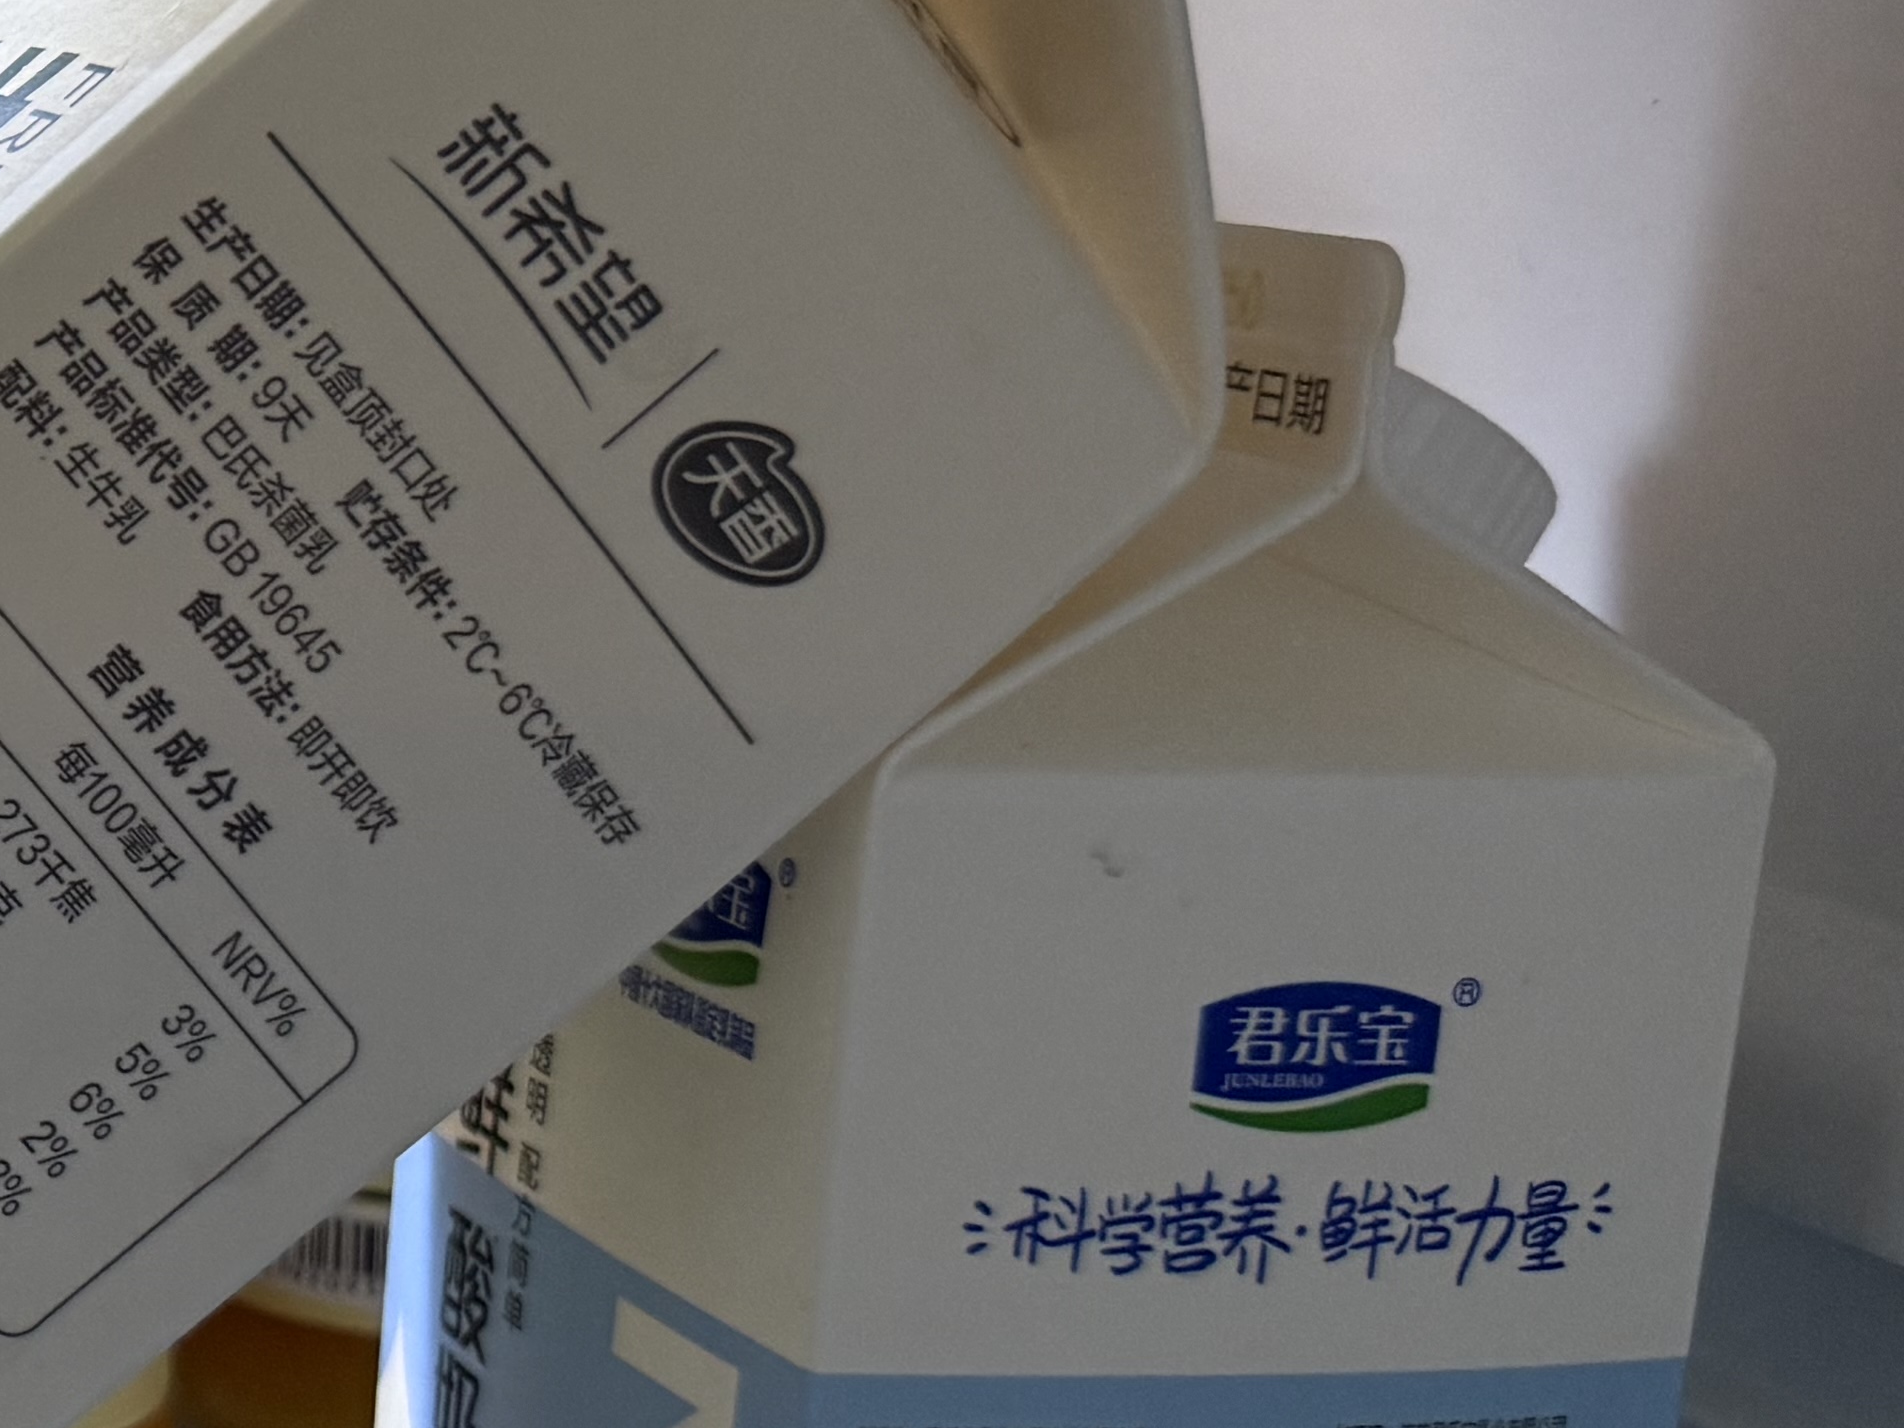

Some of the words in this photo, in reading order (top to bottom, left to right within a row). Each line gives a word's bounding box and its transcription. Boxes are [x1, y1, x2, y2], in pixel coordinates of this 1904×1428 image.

[438, 103, 663, 363] 新希望
[683, 434, 799, 575] 天香
[88, 644, 272, 854] 营养成分表
[55, 742, 185, 888] 每100毫升
[212, 931, 306, 1037] NRV%
[162, 1004, 216, 1063] 3%
[1224, 1004, 1418, 1068] 君乐宝
[115, 1042, 170, 1101] 5%
[70, 1083, 124, 1140] 6%
[20, 1121, 78, 1178] 2%
